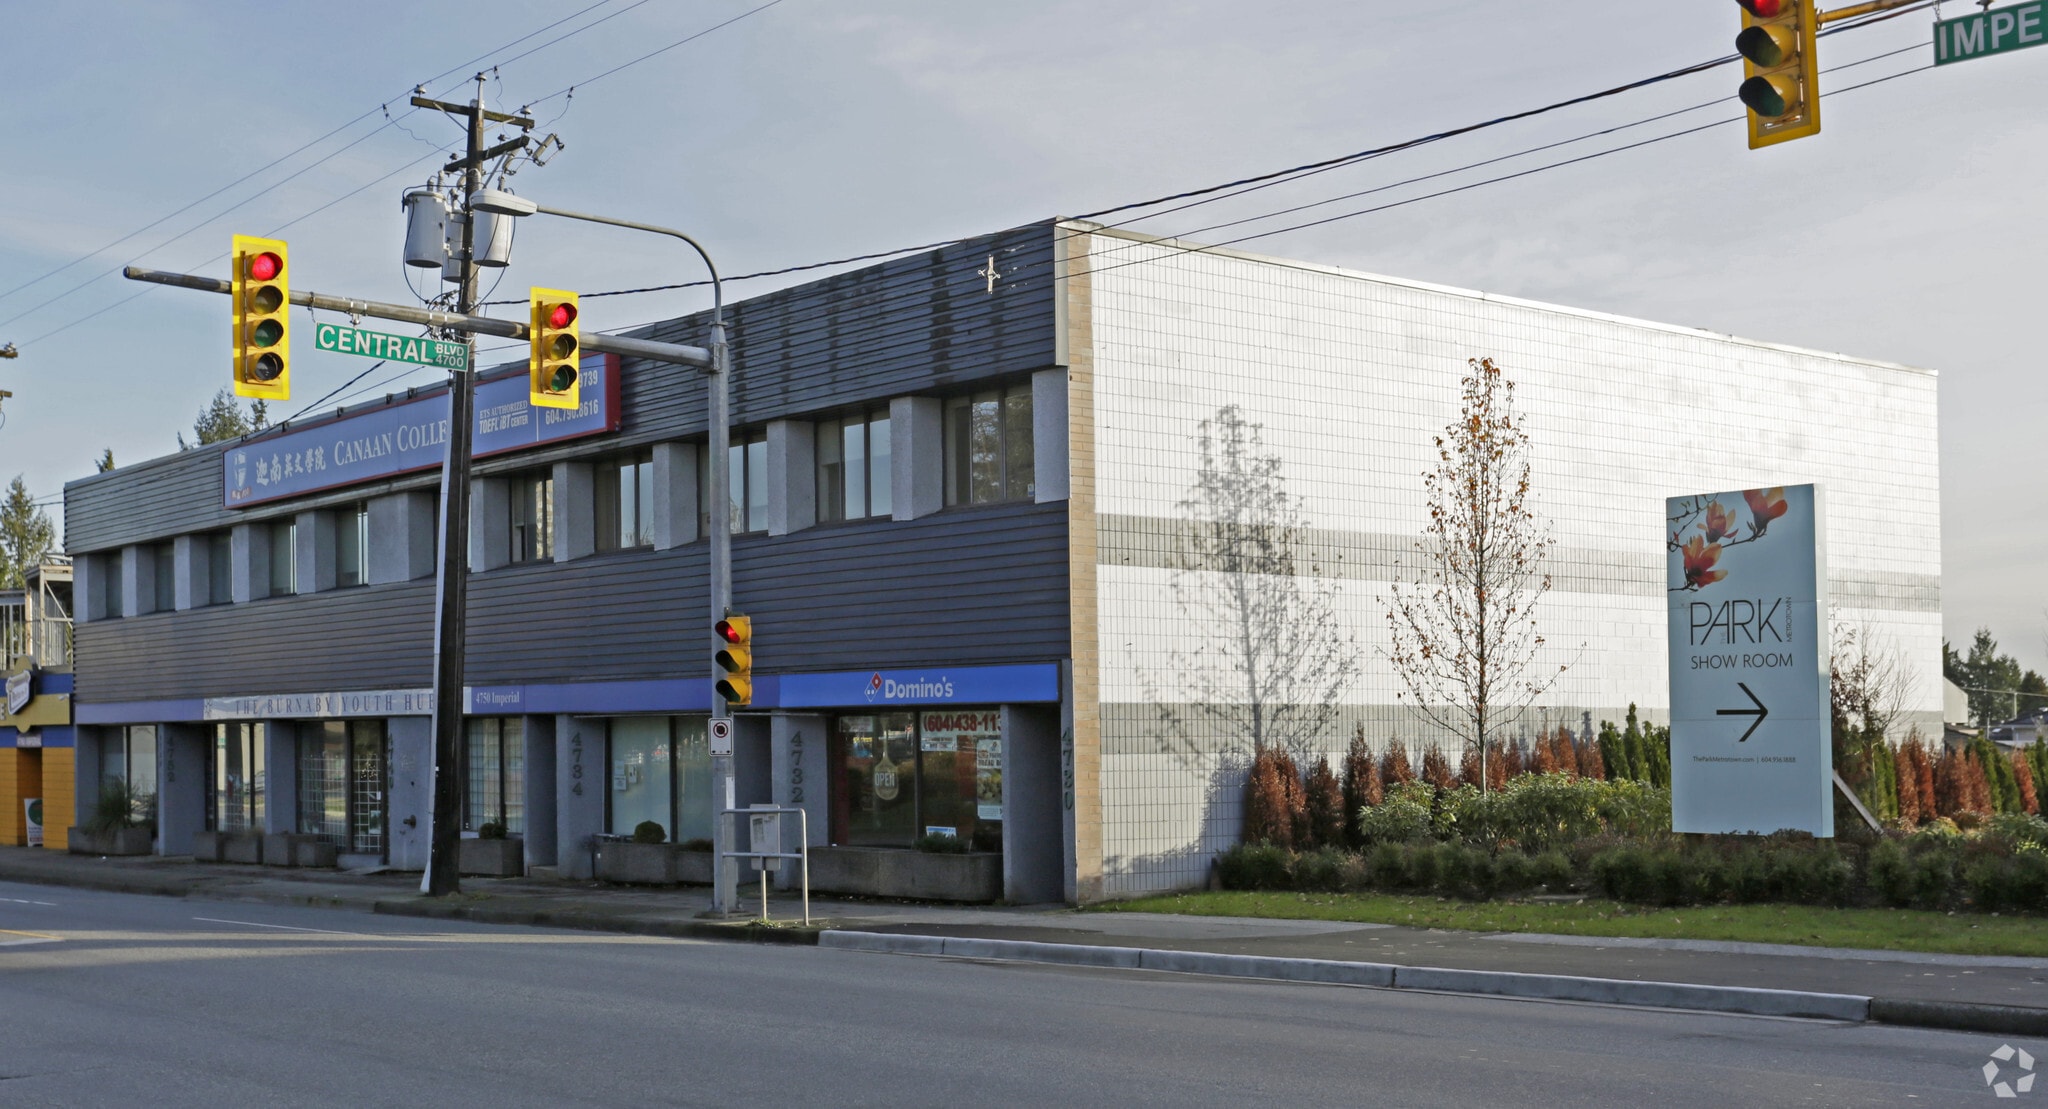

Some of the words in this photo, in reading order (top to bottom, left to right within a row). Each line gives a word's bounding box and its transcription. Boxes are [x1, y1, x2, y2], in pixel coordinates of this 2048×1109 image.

[1939, 4, 2043, 60] IMPE
[319, 325, 433, 363] CENTRAL
[435, 343, 465, 356] BLVD
[435, 356, 464, 367] 4700
[479, 409, 491, 420] ETS
[491, 400, 528, 416] AUTHORIZED
[479, 416, 499, 434] TOEFL
[511, 415, 529, 428] CENTER
[334, 432, 393, 467] CANAAN
[397, 419, 448, 452] COLLE
[1690, 597, 1783, 646] PARK
[1785, 596, 1793, 643] METROTOWN
[1690, 654, 1738, 670] SHOW
[1743, 652, 1793, 668] ROOM
[885, 676, 954, 699] Domino's
[235, 699, 258, 715] THE
[267, 696, 333, 714] BURNABY
[342, 694, 393, 712] YOUTH
[491, 691, 520, 707] Imperial
[923, 713, 1002, 732] (604)438-113
[571, 731, 584, 796] 4734
[790, 730, 804, 803] 4732
[874, 772, 895, 788] OPEN
